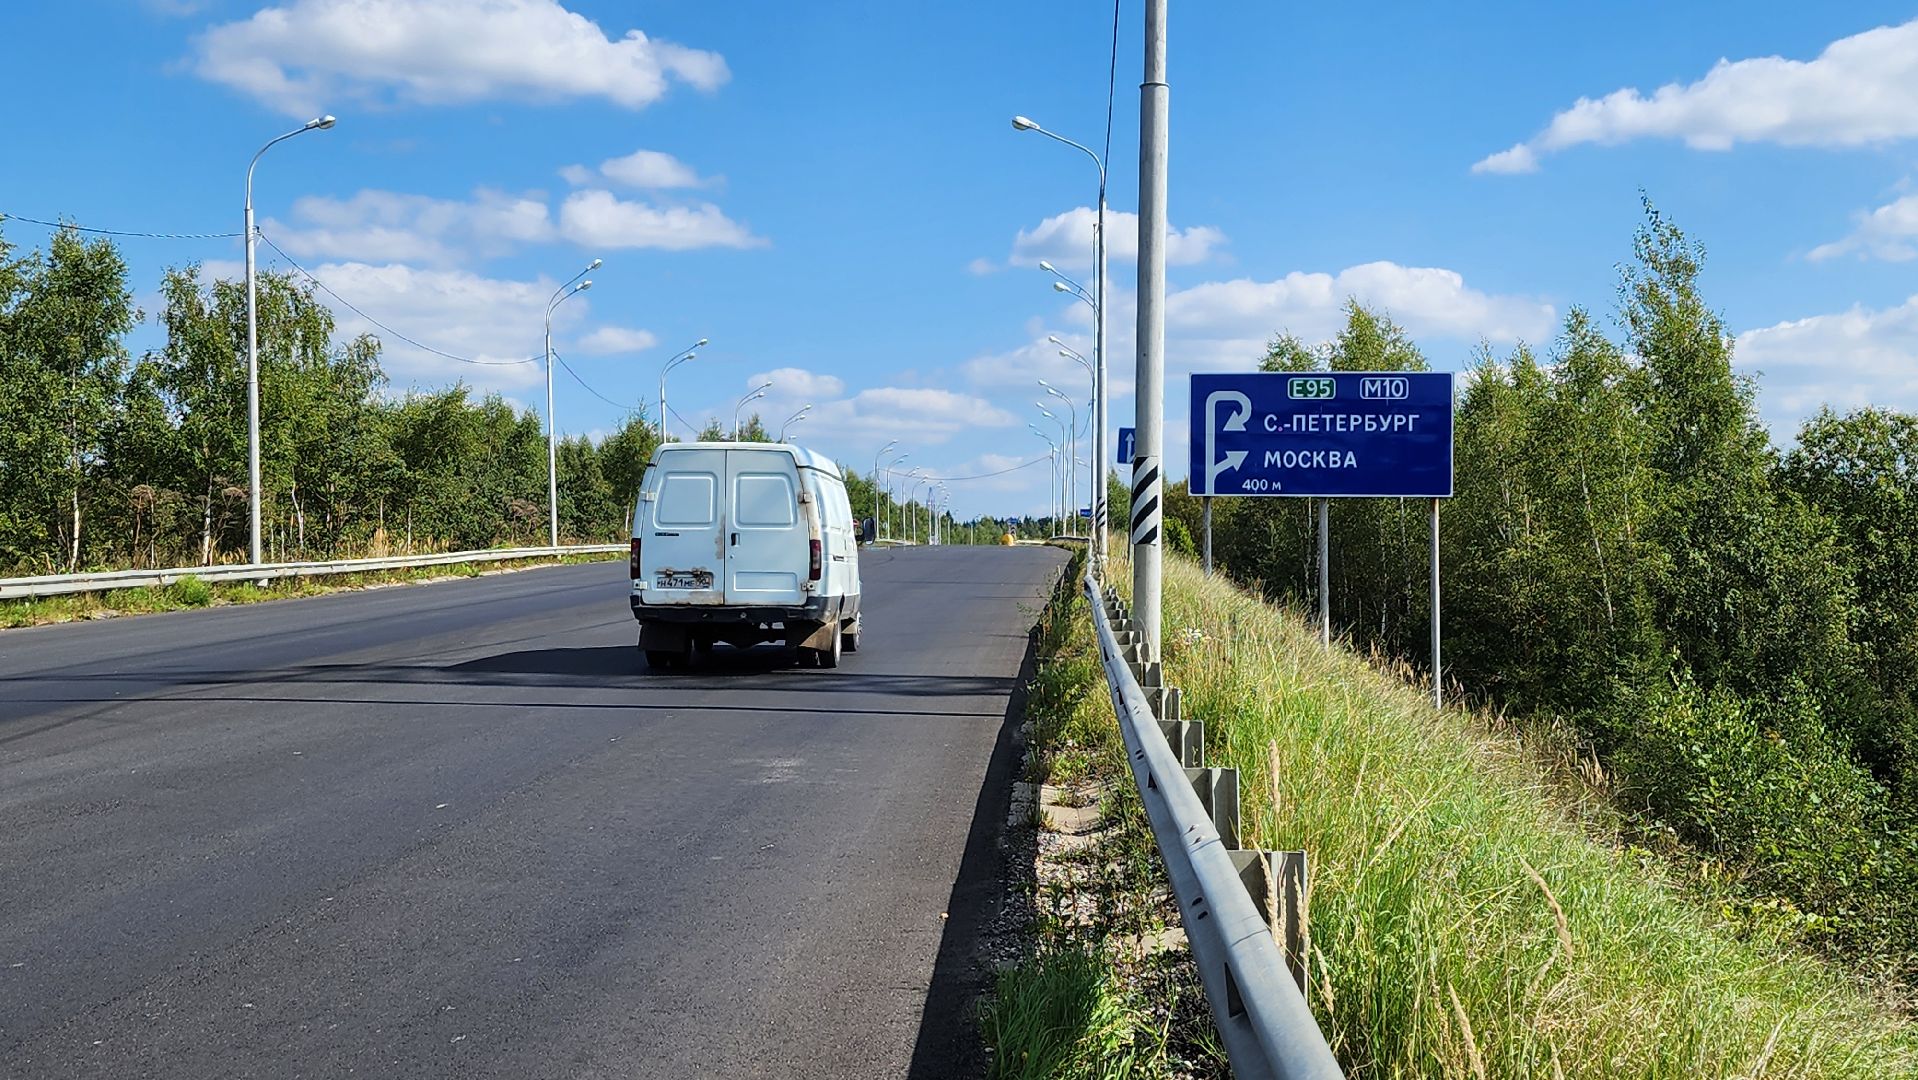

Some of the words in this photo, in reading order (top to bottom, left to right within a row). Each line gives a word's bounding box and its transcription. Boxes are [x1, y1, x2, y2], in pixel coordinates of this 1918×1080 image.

[1292, 380, 1331, 397] E95
[1364, 380, 1404, 397] М10
[1264, 414, 1420, 432] С.-ПЕТЕРБУРГ
[1264, 450, 1358, 468] МОСКВА
[1242, 479, 1268, 491] 400
